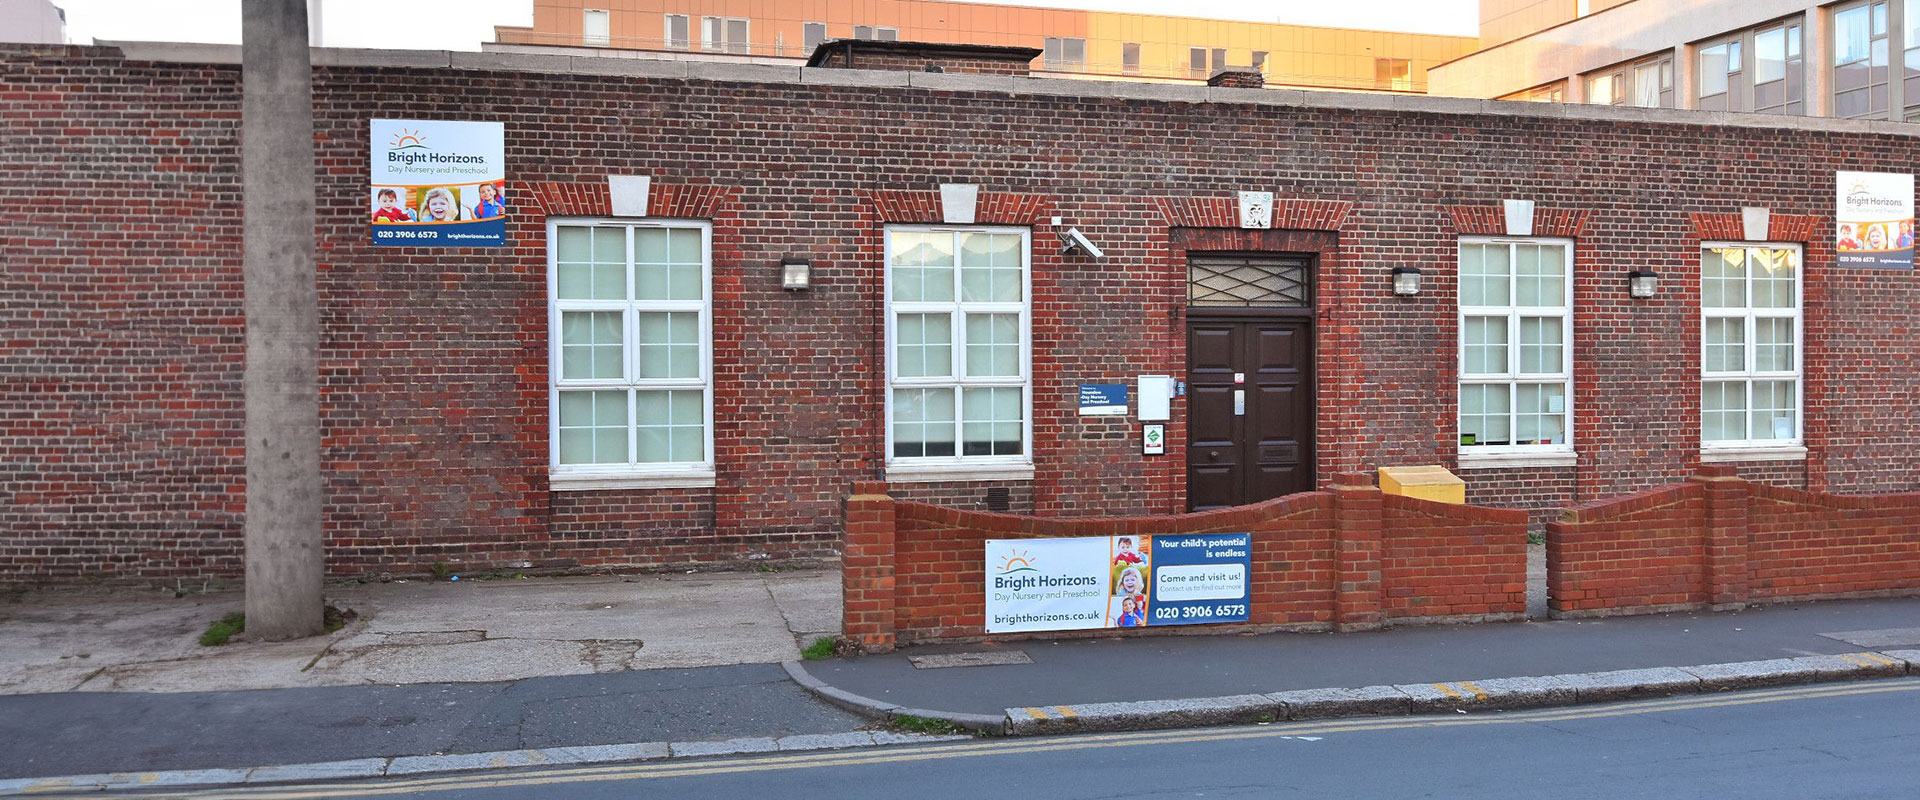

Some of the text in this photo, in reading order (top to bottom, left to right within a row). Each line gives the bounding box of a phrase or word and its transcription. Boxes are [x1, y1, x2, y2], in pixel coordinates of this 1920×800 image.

[388, 152, 484, 165] Bright Horizons
[388, 165, 402, 174] Day
[404, 165, 435, 175] Nursery
[1846, 196, 1902, 206] Bright Horizons
[1160, 538, 1246, 548] Your child's potential
[1206, 549, 1246, 558] is endless
[1160, 572, 1241, 582] Come and visit us!
[995, 574, 1097, 592] Bright Horizons
[994, 589, 1100, 602] Day Nursery and Preschool
[1156, 604, 1246, 618] 020 3906 6573
[994, 610, 1100, 626] brighthorizons.co.uk
